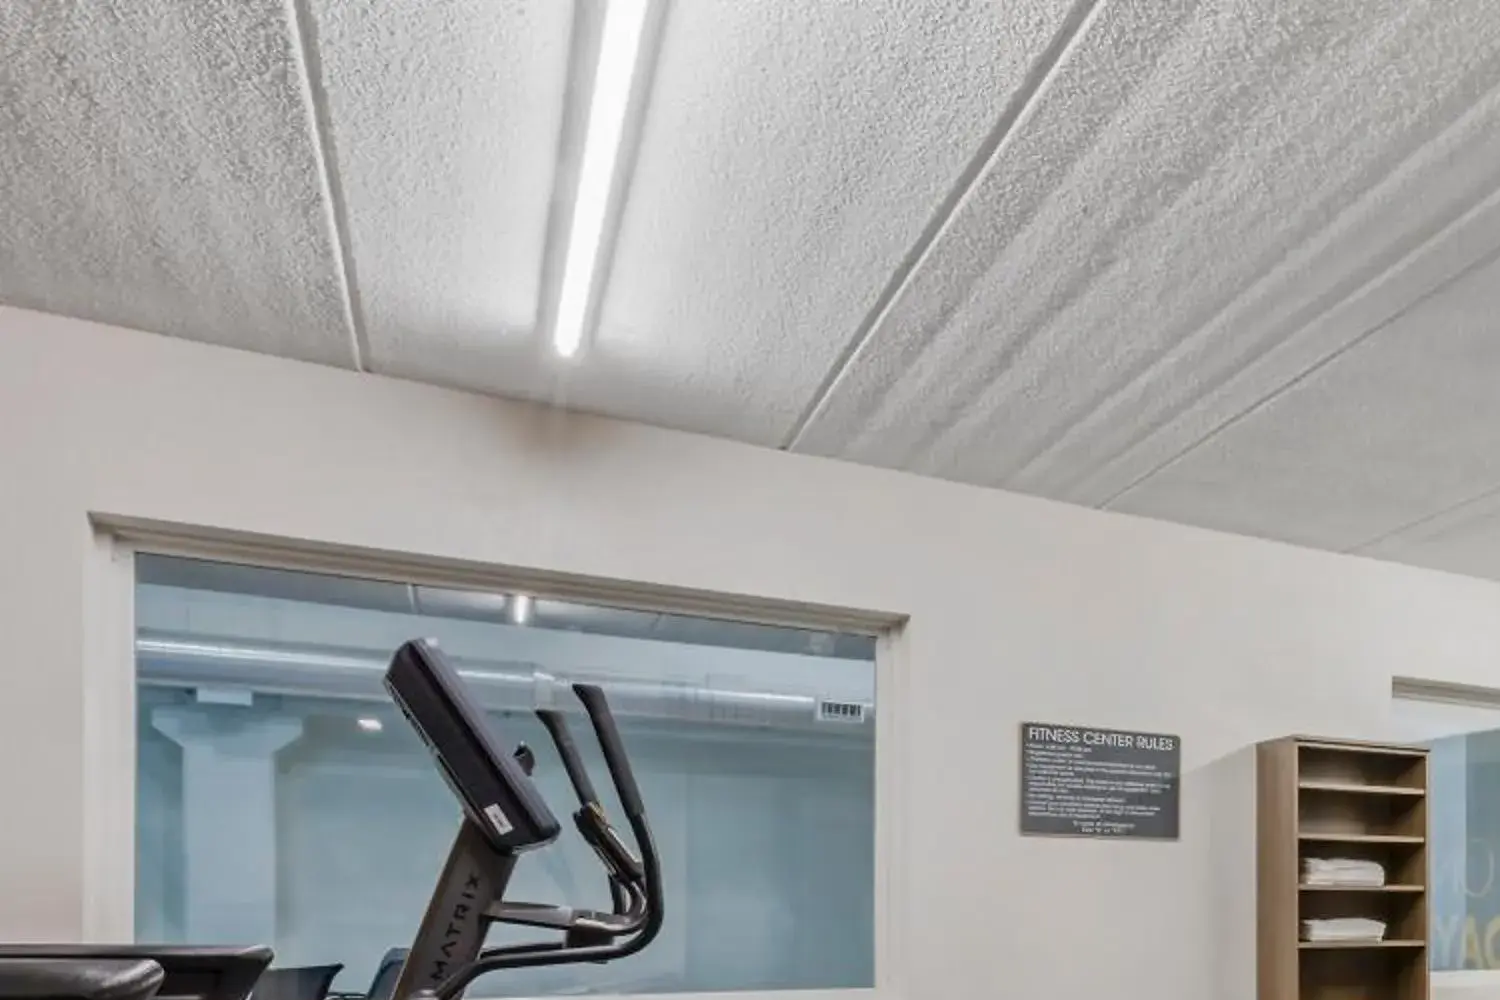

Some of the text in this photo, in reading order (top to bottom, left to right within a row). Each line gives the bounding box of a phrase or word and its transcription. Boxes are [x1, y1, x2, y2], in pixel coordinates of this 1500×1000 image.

[1029, 727, 1174, 751] FITNESS CENTER RULES
[430, 873, 479, 981] MATRIX
